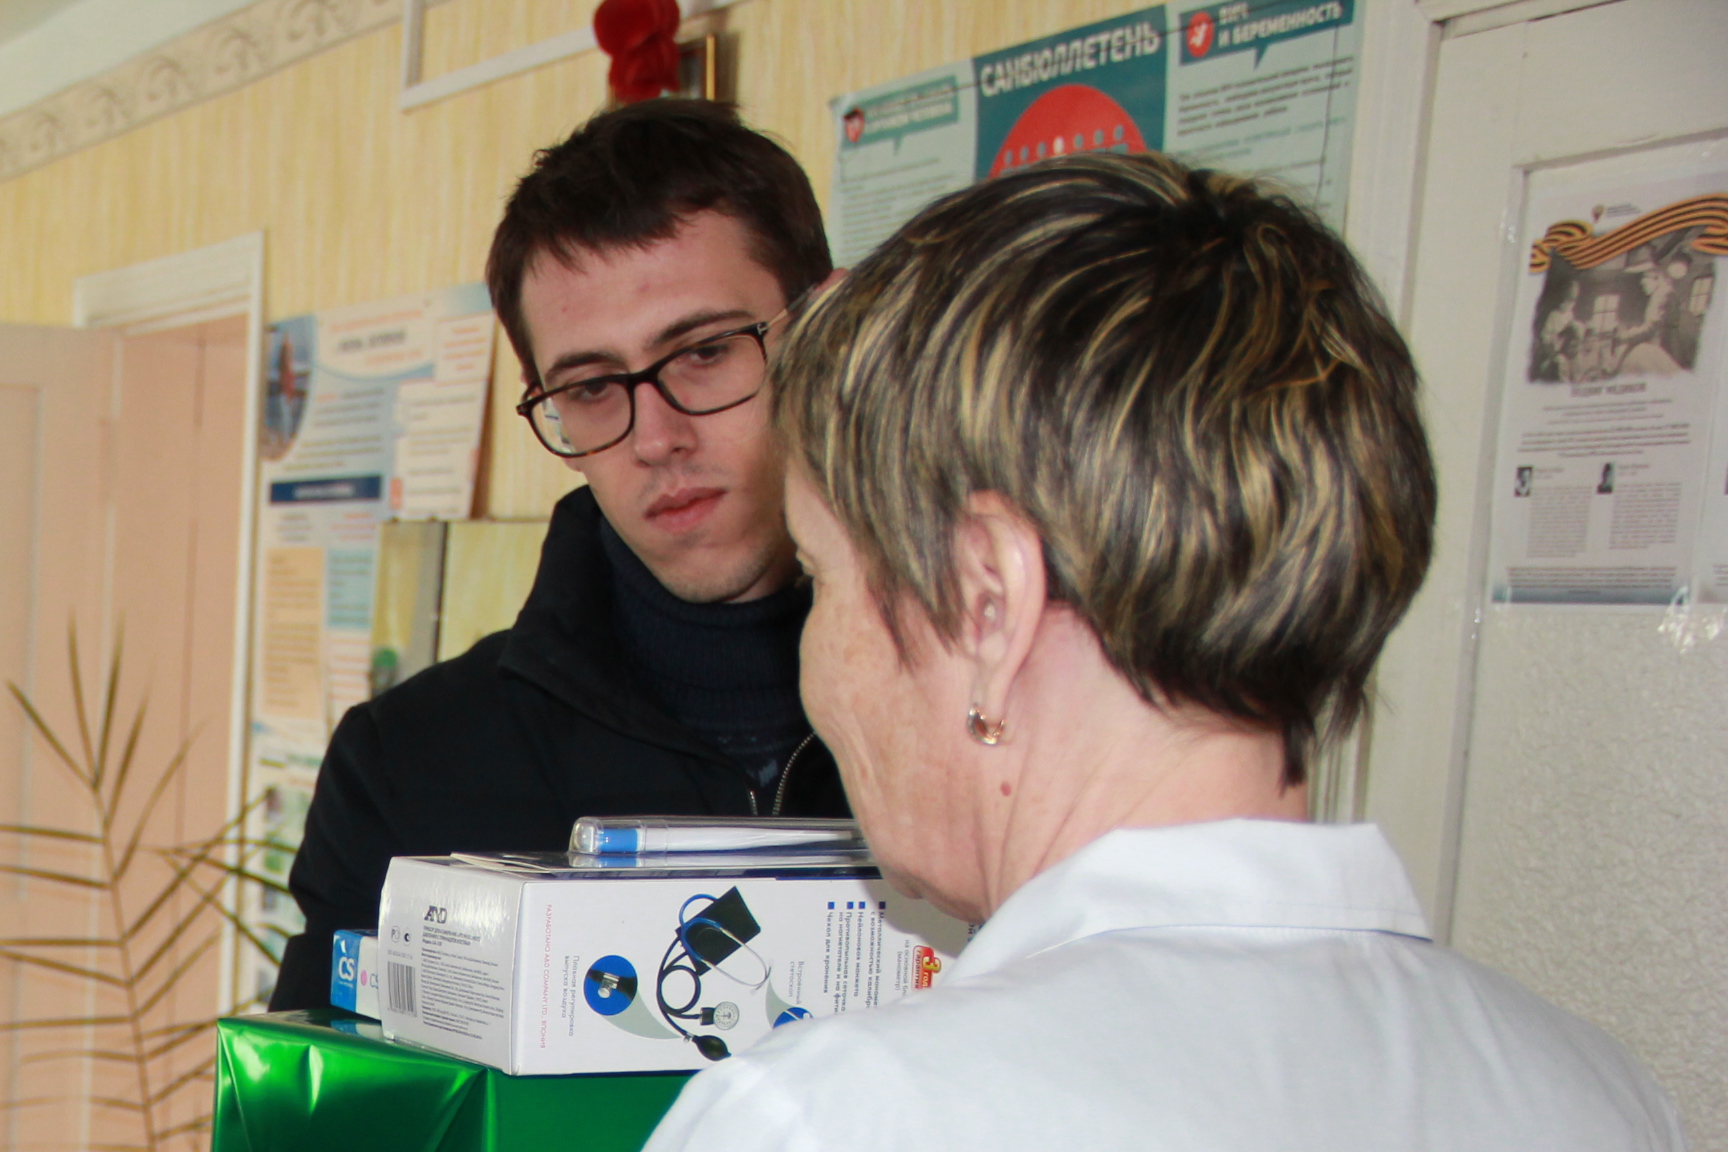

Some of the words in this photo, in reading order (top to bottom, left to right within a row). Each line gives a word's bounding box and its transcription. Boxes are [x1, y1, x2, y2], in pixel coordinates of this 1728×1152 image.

[1219, 29, 1231, 48] И
[1232, 1, 1343, 44] БЕРЕМЕННОСТЬ
[981, 21, 1161, 97] САНБЮЛЛЕТЕНЬ
[544, 905, 552, 951] РАЗРАБОТАНО
[825, 912, 834, 937] Чехол
[839, 912, 843, 922] на
[843, 912, 852, 978] Противопыльная
[856, 912, 864, 960] Нейлоновая
[875, 912, 884, 973] Металлический
[905, 940, 910, 948] на
[338, 956, 355, 982] CS
[571, 956, 579, 987] Плавная
[787, 961, 796, 997] стетоскоп
[823, 955, 831, 993] хранения
[853, 962, 861, 996] манжета
[922, 956, 940, 971] 3
[922, 972, 930, 989] год
[795, 961, 804, 1004] Встроенный
[835, 981, 840, 991] на
[560, 988, 568, 1018] воздуха
[568, 990, 576, 1036] регулировка
